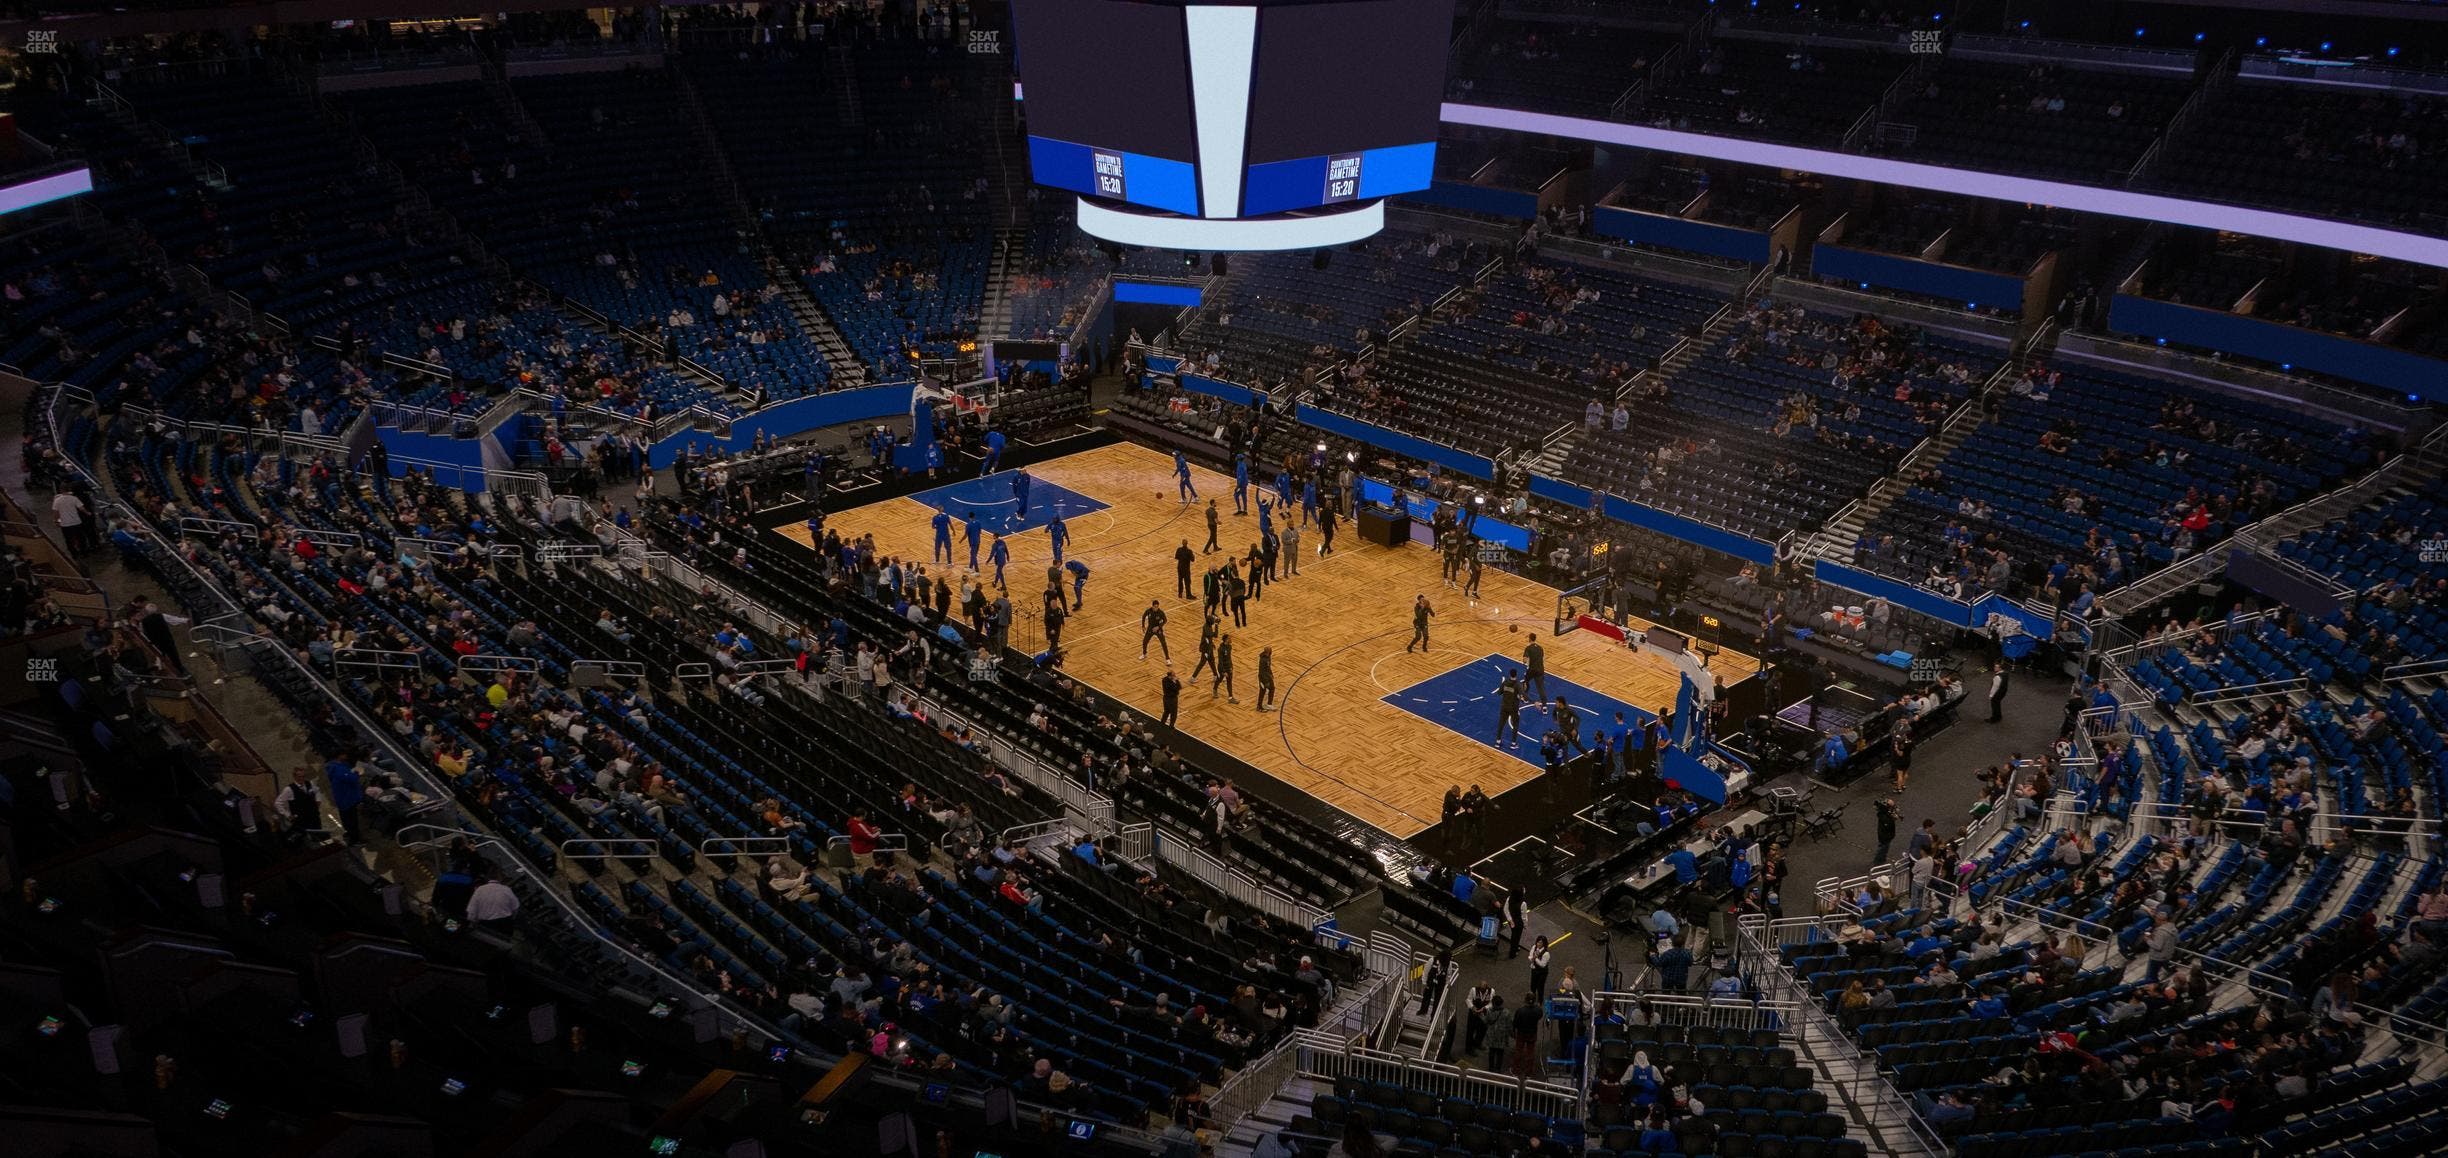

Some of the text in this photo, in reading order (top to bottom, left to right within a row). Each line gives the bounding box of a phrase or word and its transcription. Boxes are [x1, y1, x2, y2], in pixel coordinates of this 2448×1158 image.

[1096, 161, 1122, 177] GAMETIME
[1330, 165, 1359, 180] GAMETIME
[1101, 176, 1121, 194] 15:20
[1331, 180, 1354, 197] 15:20
